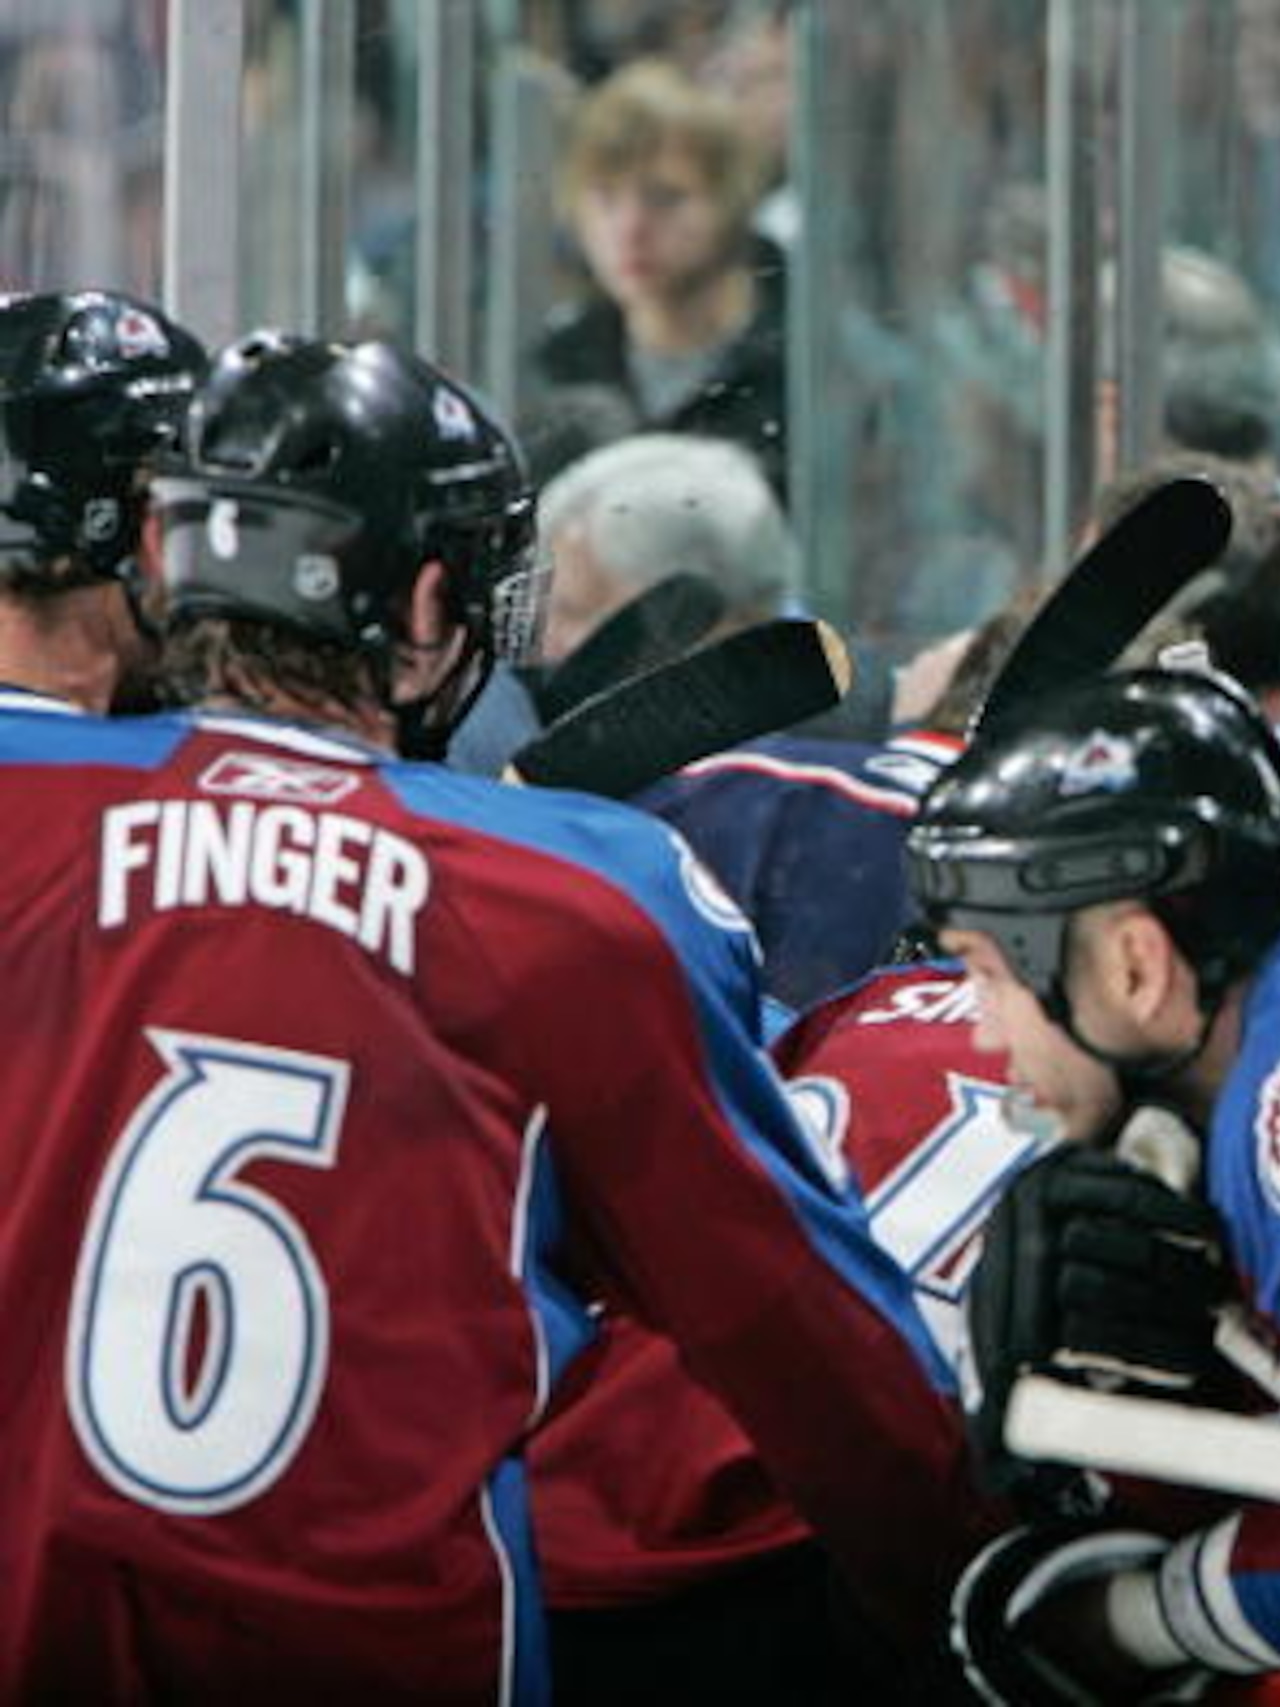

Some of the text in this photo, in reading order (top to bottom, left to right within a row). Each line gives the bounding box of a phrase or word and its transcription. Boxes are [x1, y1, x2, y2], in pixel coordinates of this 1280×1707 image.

[207, 498, 239, 559] 6
[99, 800, 429, 975] FINGER
[64, 1026, 350, 1525] 6
